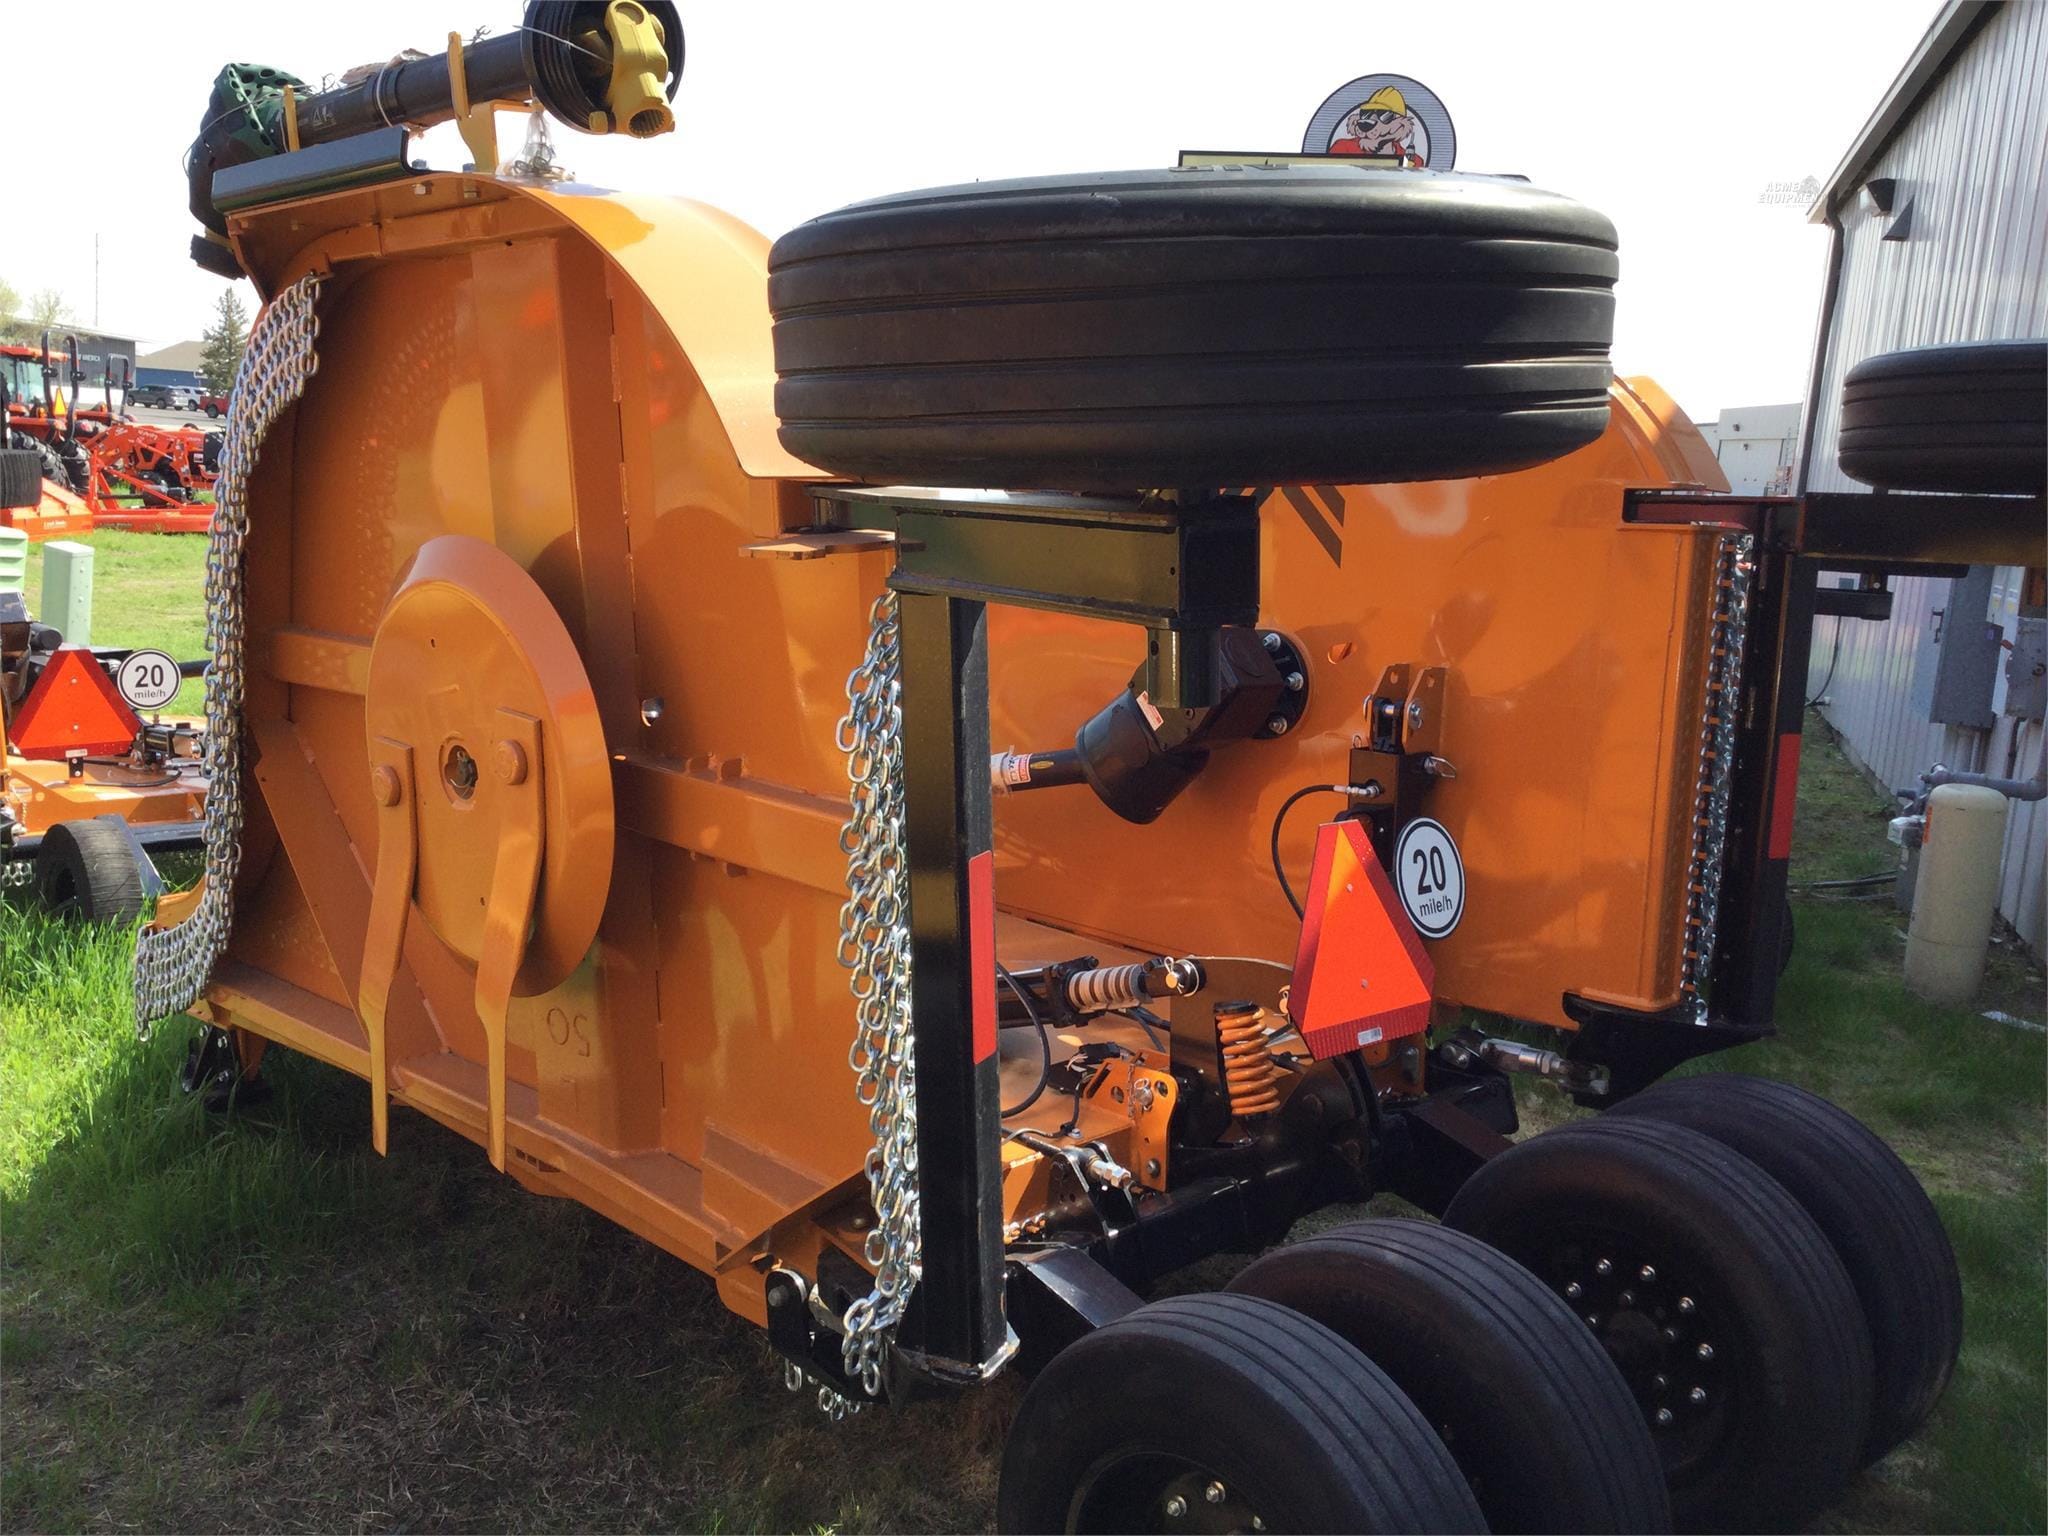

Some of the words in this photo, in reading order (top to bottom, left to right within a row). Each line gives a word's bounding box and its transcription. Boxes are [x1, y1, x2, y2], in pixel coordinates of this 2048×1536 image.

[134, 664, 164, 688] 20
[134, 688, 167, 700] mile/h
[1413, 845, 1447, 896] 20
[1419, 895, 1453, 918] mile/h
